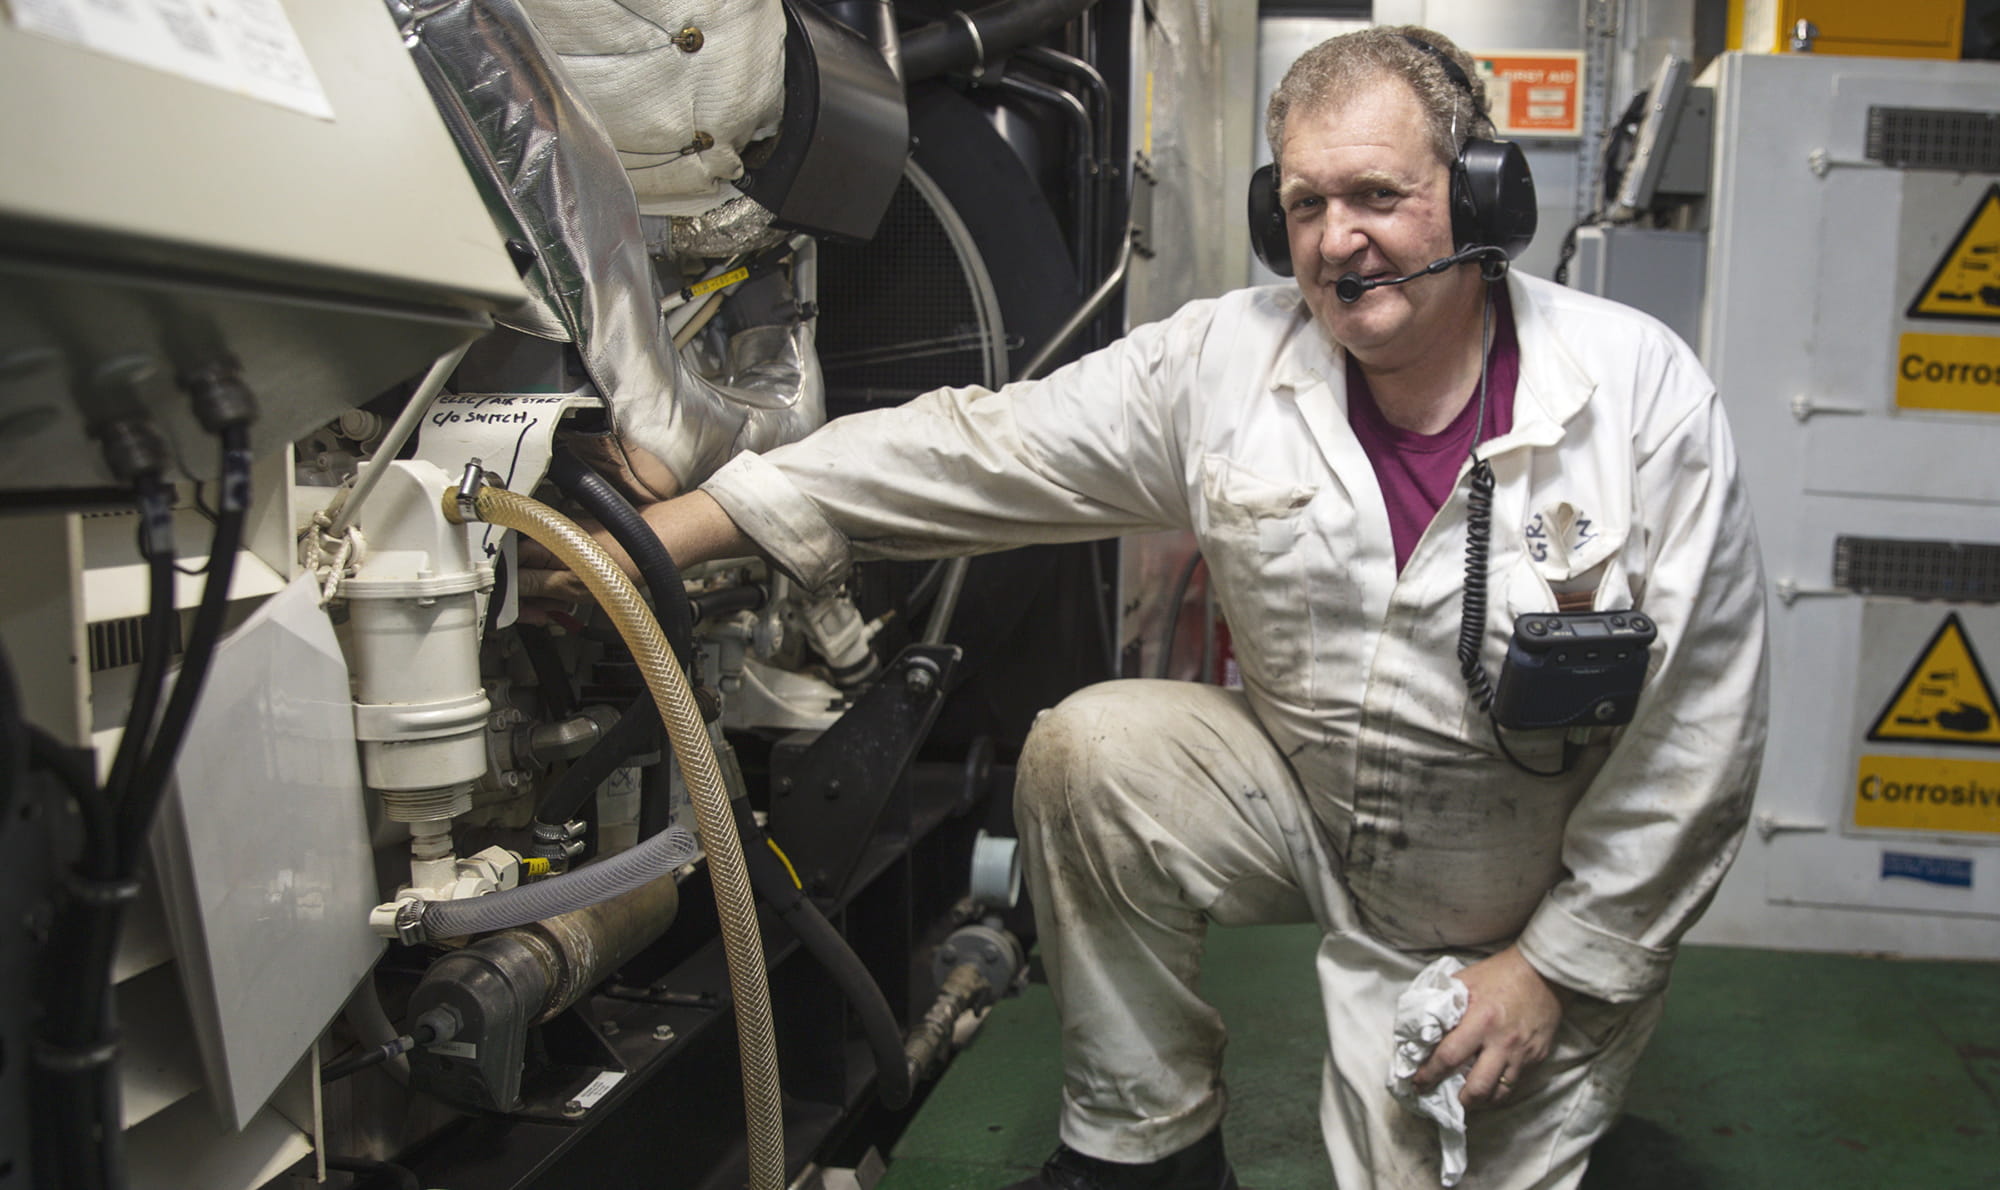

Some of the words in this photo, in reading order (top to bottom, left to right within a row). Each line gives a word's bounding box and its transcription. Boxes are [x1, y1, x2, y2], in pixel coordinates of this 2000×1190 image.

[1502, 68, 1544, 84] FIRST
[1549, 69, 1576, 85] AID
[464, 411, 528, 424] SWITCH
[1860, 773, 2000, 808] Corrosiv
